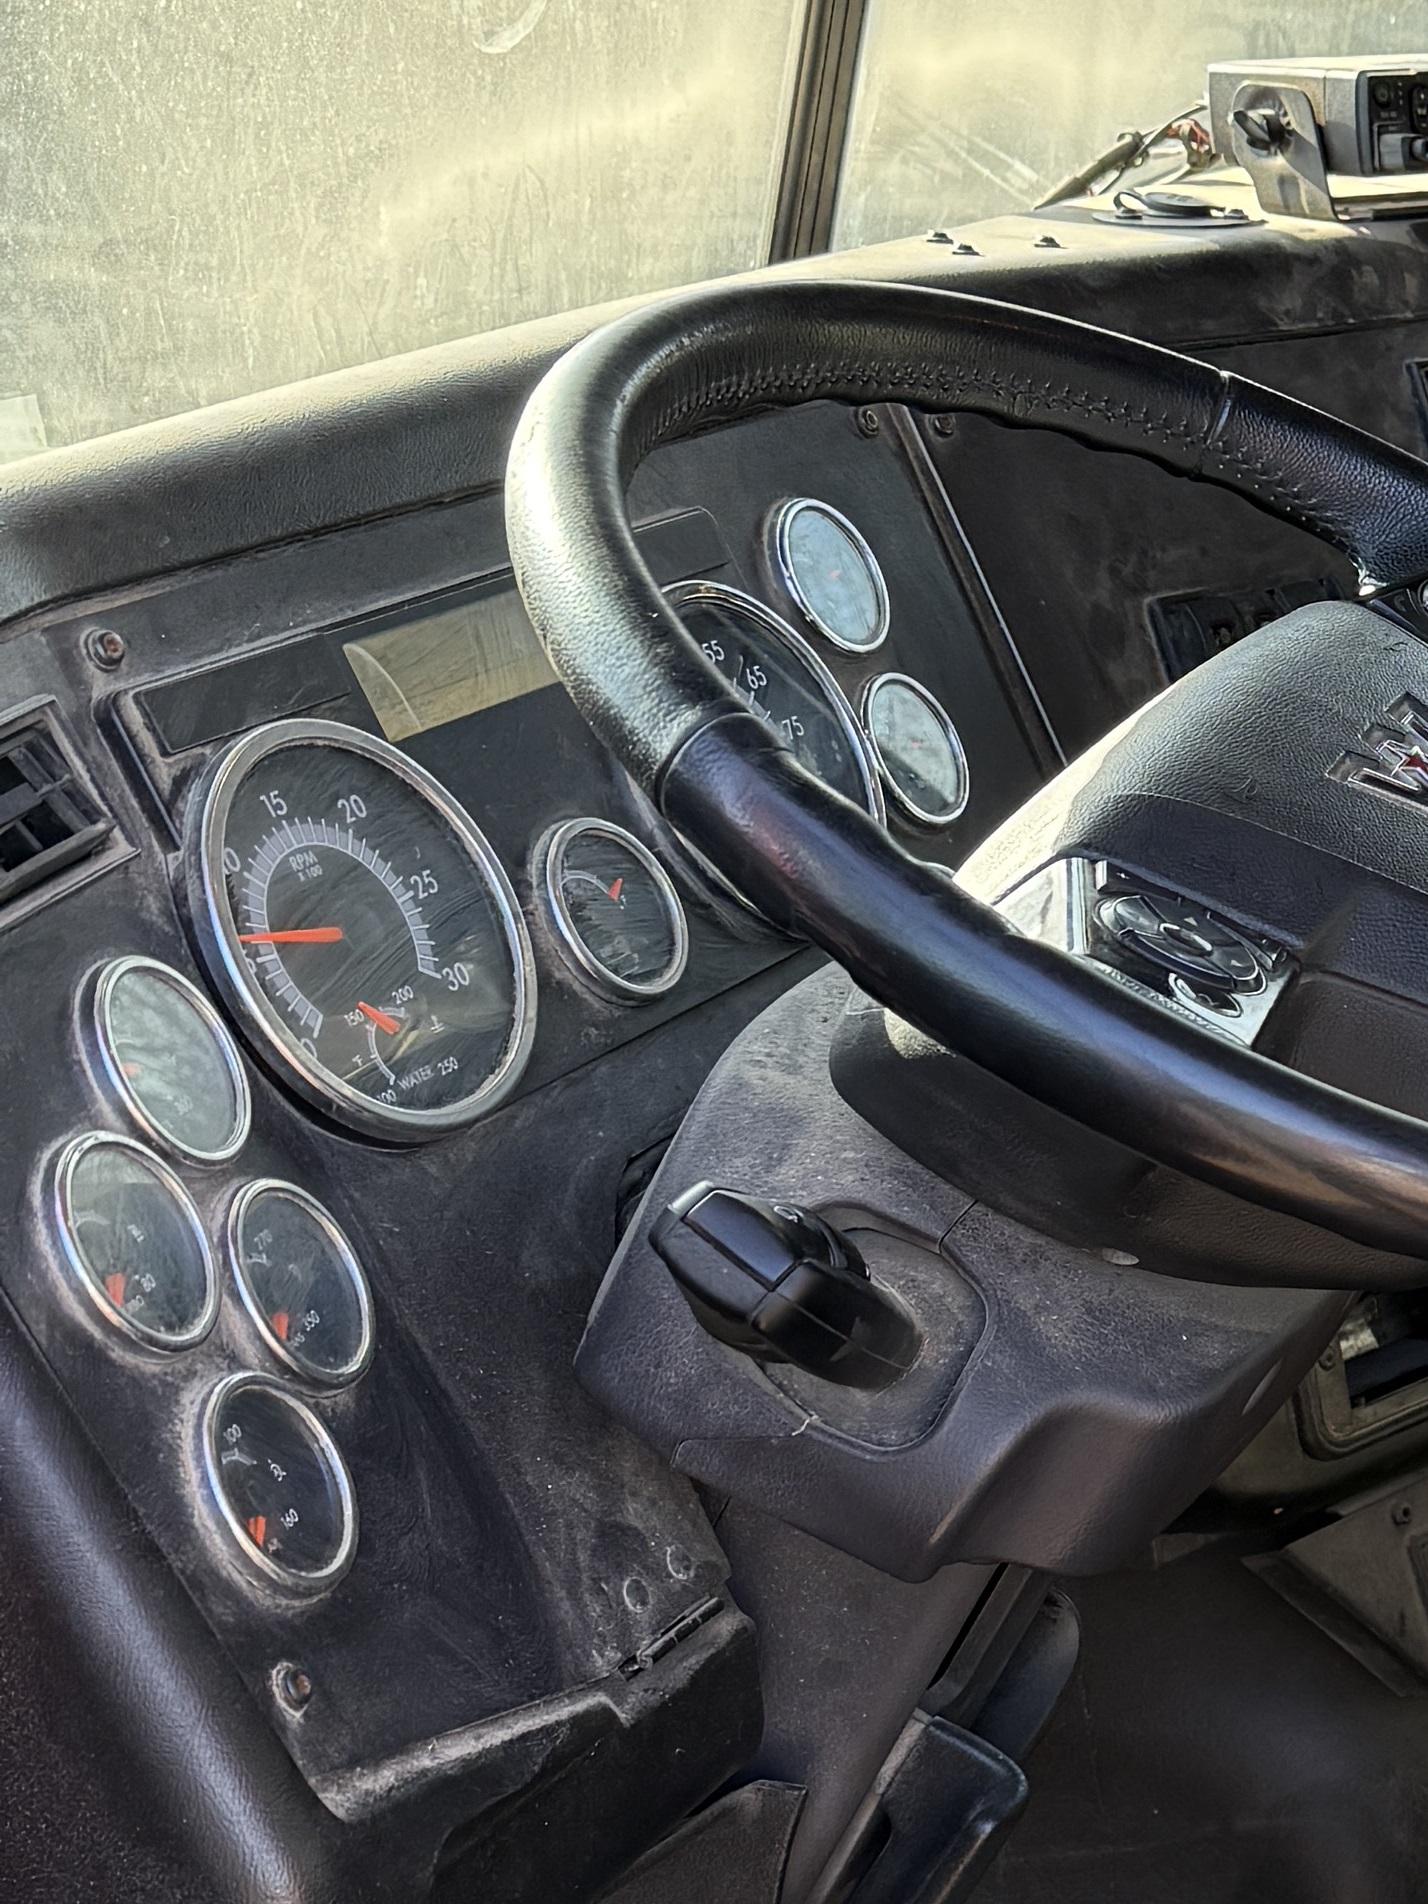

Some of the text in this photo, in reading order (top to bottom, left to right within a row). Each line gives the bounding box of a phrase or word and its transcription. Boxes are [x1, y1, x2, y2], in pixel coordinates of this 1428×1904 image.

[702, 640, 725, 663] 55
[746, 665, 767, 689] 65
[782, 716, 804, 740] 75
[260, 790, 288, 818] 15
[337, 794, 367, 824] 20
[288, 850, 319, 874] RPM
[306, 863, 323, 879] 100
[411, 870, 438, 900] 25
[443, 962, 469, 992] 30
[391, 984, 415, 1005] 200
[343, 1008, 365, 1028] 150
[398, 1065, 435, 1091] WATER
[438, 1057, 459, 1076] 250
[280, 1508, 299, 1530] 160
